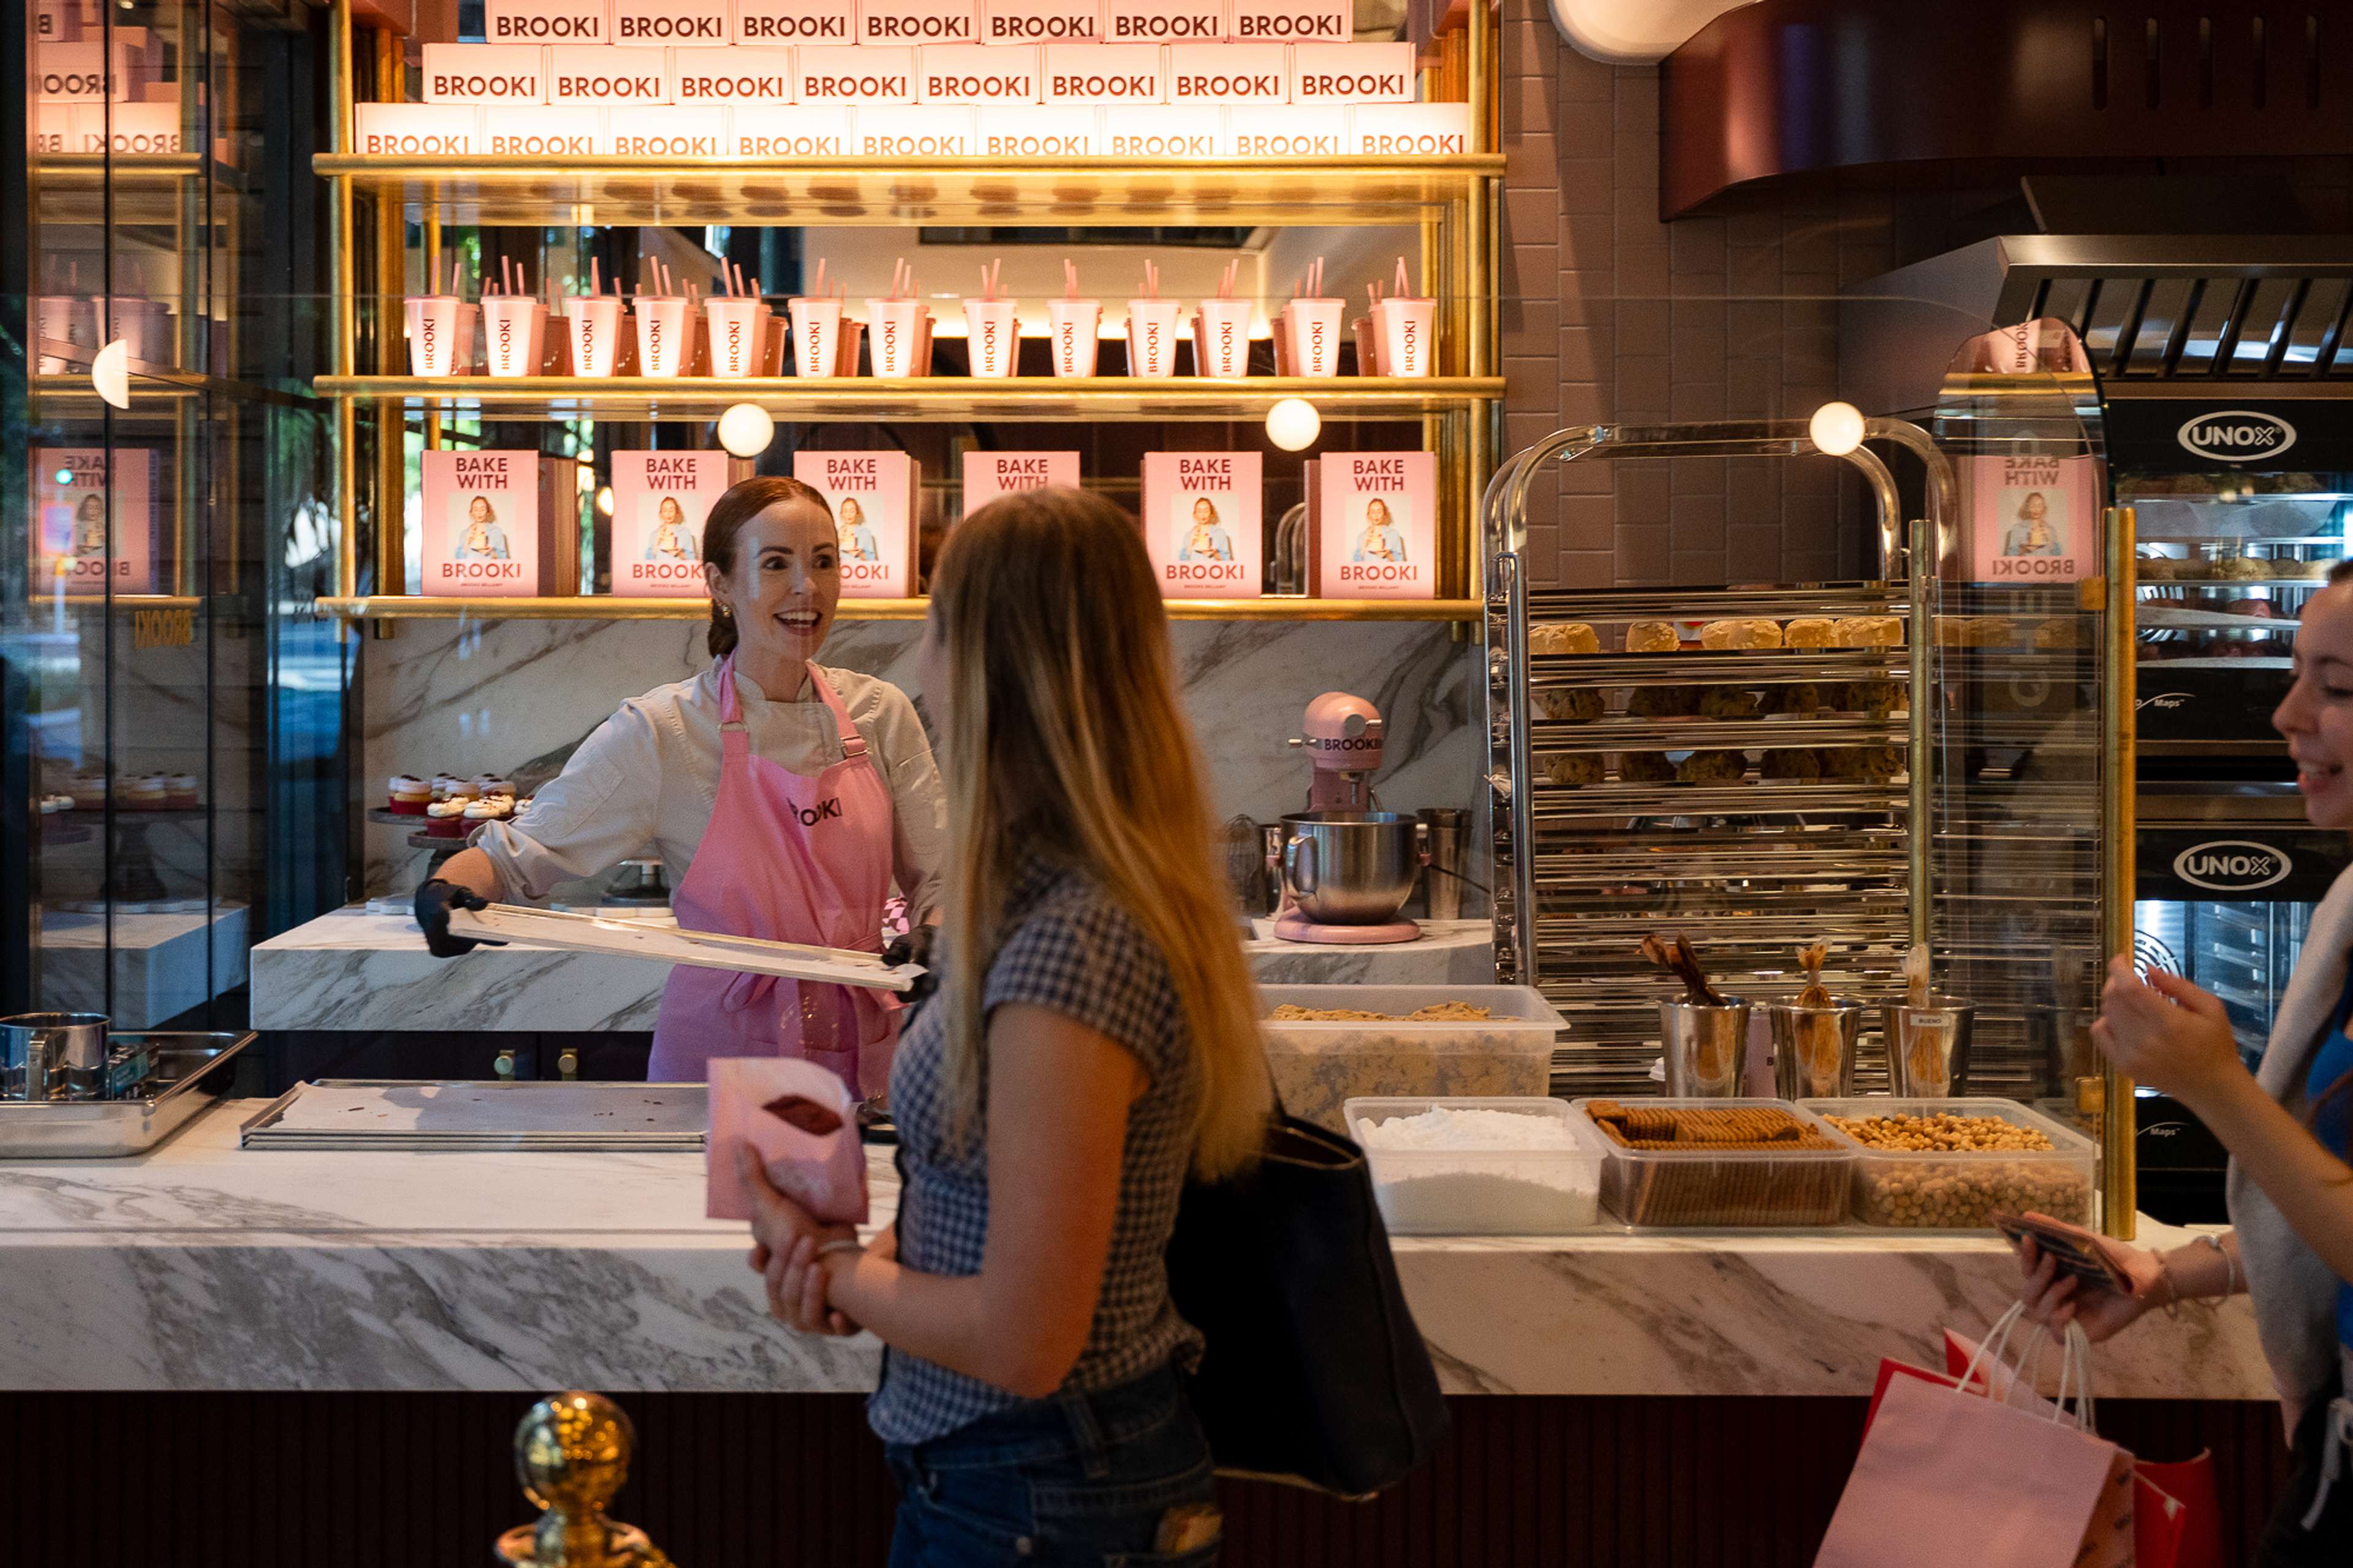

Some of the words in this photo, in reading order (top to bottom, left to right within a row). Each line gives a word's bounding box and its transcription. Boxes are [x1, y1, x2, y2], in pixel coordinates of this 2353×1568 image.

[497, 17, 597, 37] BROOKI
[621, 17, 721, 37] BROOKI
[745, 17, 844, 37] BROOKI
[868, 17, 969, 37] BROOKI
[993, 17, 1093, 37] BROOKI
[1116, 16, 1217, 36] BROOKI
[1240, 15, 1341, 36] BROOKI
[434, 76, 534, 96] BROOKI
[559, 77, 659, 97] BROOKI
[682, 77, 782, 97] BROOKI
[806, 77, 906, 96] BROOKI
[929, 77, 1029, 96] BROOKI
[1053, 77, 1154, 96] BROOKI
[1178, 76, 1278, 96] BROOKI
[1303, 75, 1403, 95] BROOKI
[367, 135, 469, 154] BROOKI
[492, 137, 593, 154] BROOKI
[615, 137, 716, 154] BROOKI
[740, 137, 839, 154] BROOKI
[864, 137, 963, 154] BROOKI
[988, 137, 1088, 154] BROOKI
[1113, 137, 1213, 154] BROOKI
[1238, 136, 1338, 154] BROOKI
[1363, 135, 1463, 154] BROOKI
[423, 319, 434, 369] BROOKI
[500, 320, 510, 369] BROOKI
[582, 320, 593, 369] BROOKI
[651, 320, 661, 370] BROOKI
[729, 321, 740, 371] BROOKI
[809, 322, 820, 371] BROOKI
[885, 321, 895, 371] BROOKI
[985, 321, 995, 371] BROOKI
[1063, 322, 1073, 372] BROOKI
[1147, 323, 1158, 373] BROOKI
[1221, 322, 1232, 372] BROOKI
[1312, 322, 1322, 371] BROOKI
[1404, 321, 1415, 371] BROOKI
[2192, 426, 2275, 445] UNOX
[456, 458, 507, 472] BAKE
[646, 459, 696, 472] BAKE
[827, 459, 876, 473] BAKE
[997, 459, 1048, 473] BAKE
[1180, 459, 1231, 473] BAKE
[1354, 460, 1404, 474] BAKE
[457, 475, 507, 489] WITH
[647, 475, 696, 490] WITH
[828, 476, 876, 490] WITH
[998, 476, 1048, 490] WITH
[1181, 476, 1231, 490] WITH
[1354, 477, 1404, 491] WITH
[442, 563, 521, 578] BROOKI
[633, 564, 702, 578] BROOK
[841, 565, 889, 580] OOKI
[1167, 565, 1244, 579] BROOKI
[1341, 566, 1417, 580] BROOKI
[2188, 856, 2270, 876] UNOX
